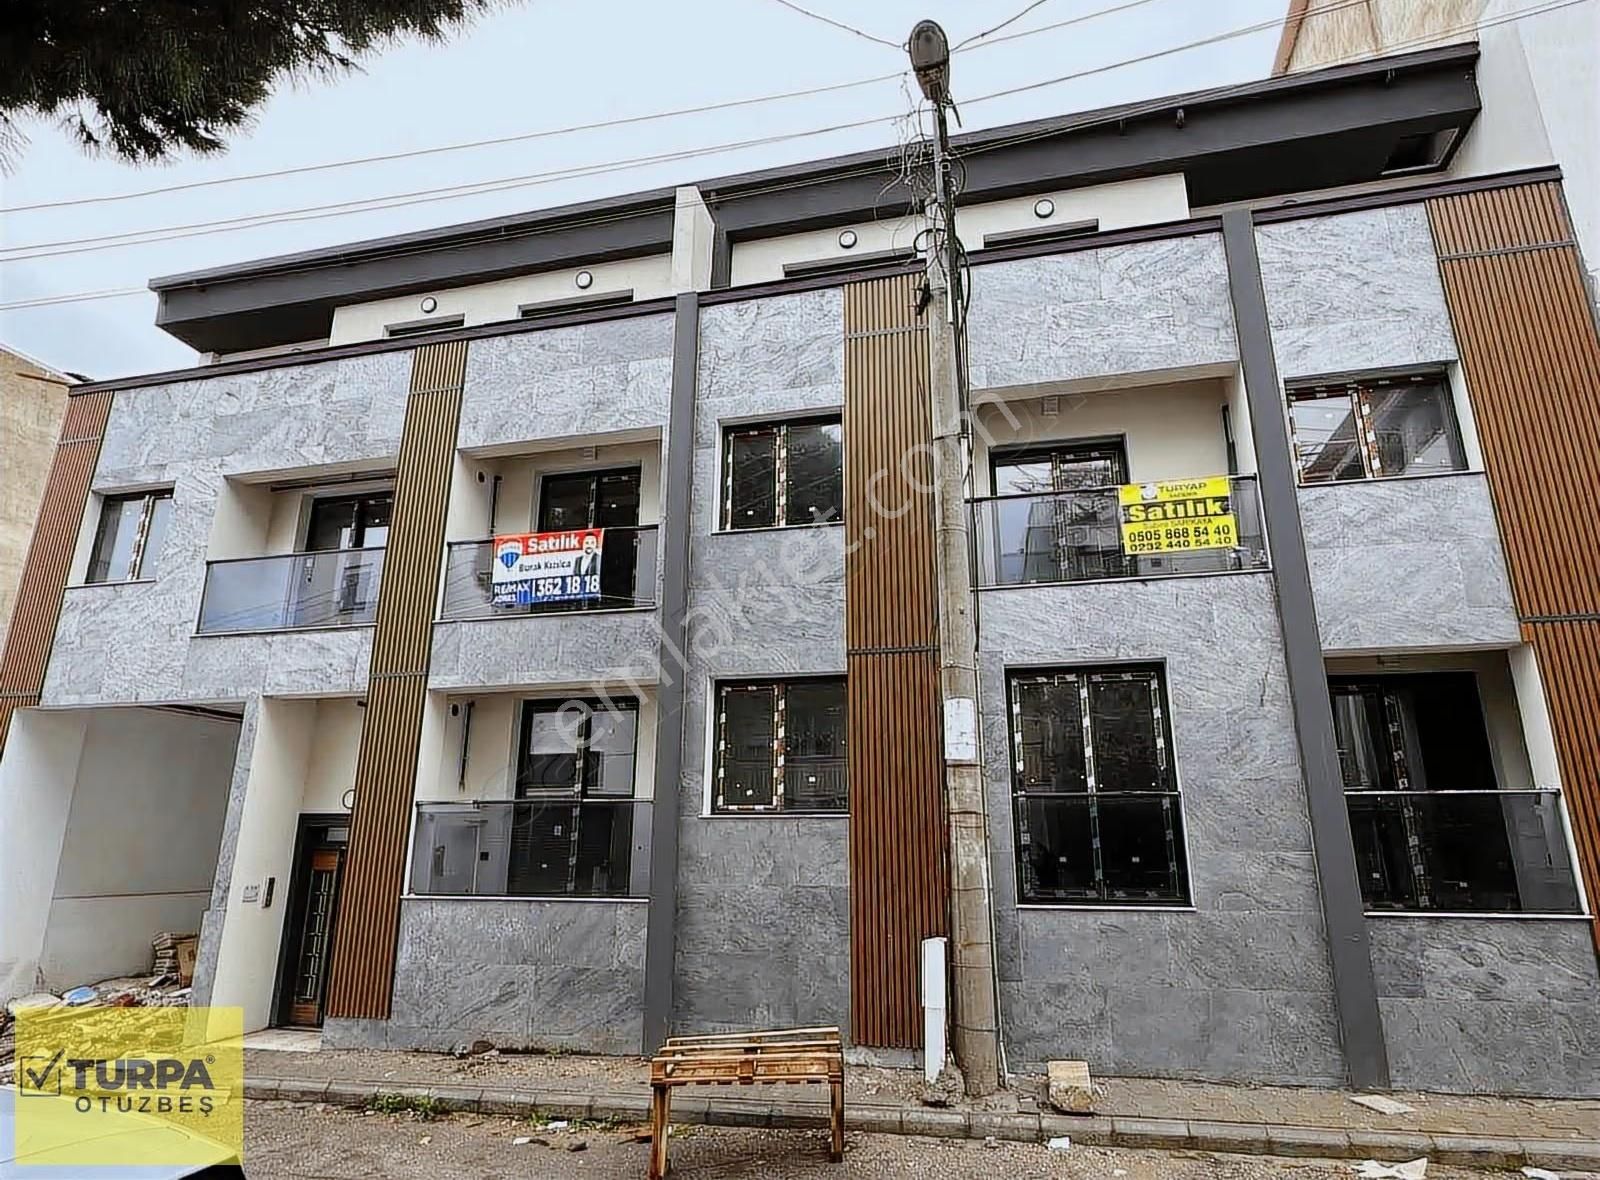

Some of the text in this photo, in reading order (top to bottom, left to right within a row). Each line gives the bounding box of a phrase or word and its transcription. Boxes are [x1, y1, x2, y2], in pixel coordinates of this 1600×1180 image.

[1129, 524, 1230, 543] 0505 868 54 40
[1130, 536, 1231, 552] 0232 440 54 40
[537, 574, 600, 597] 362 18 18
